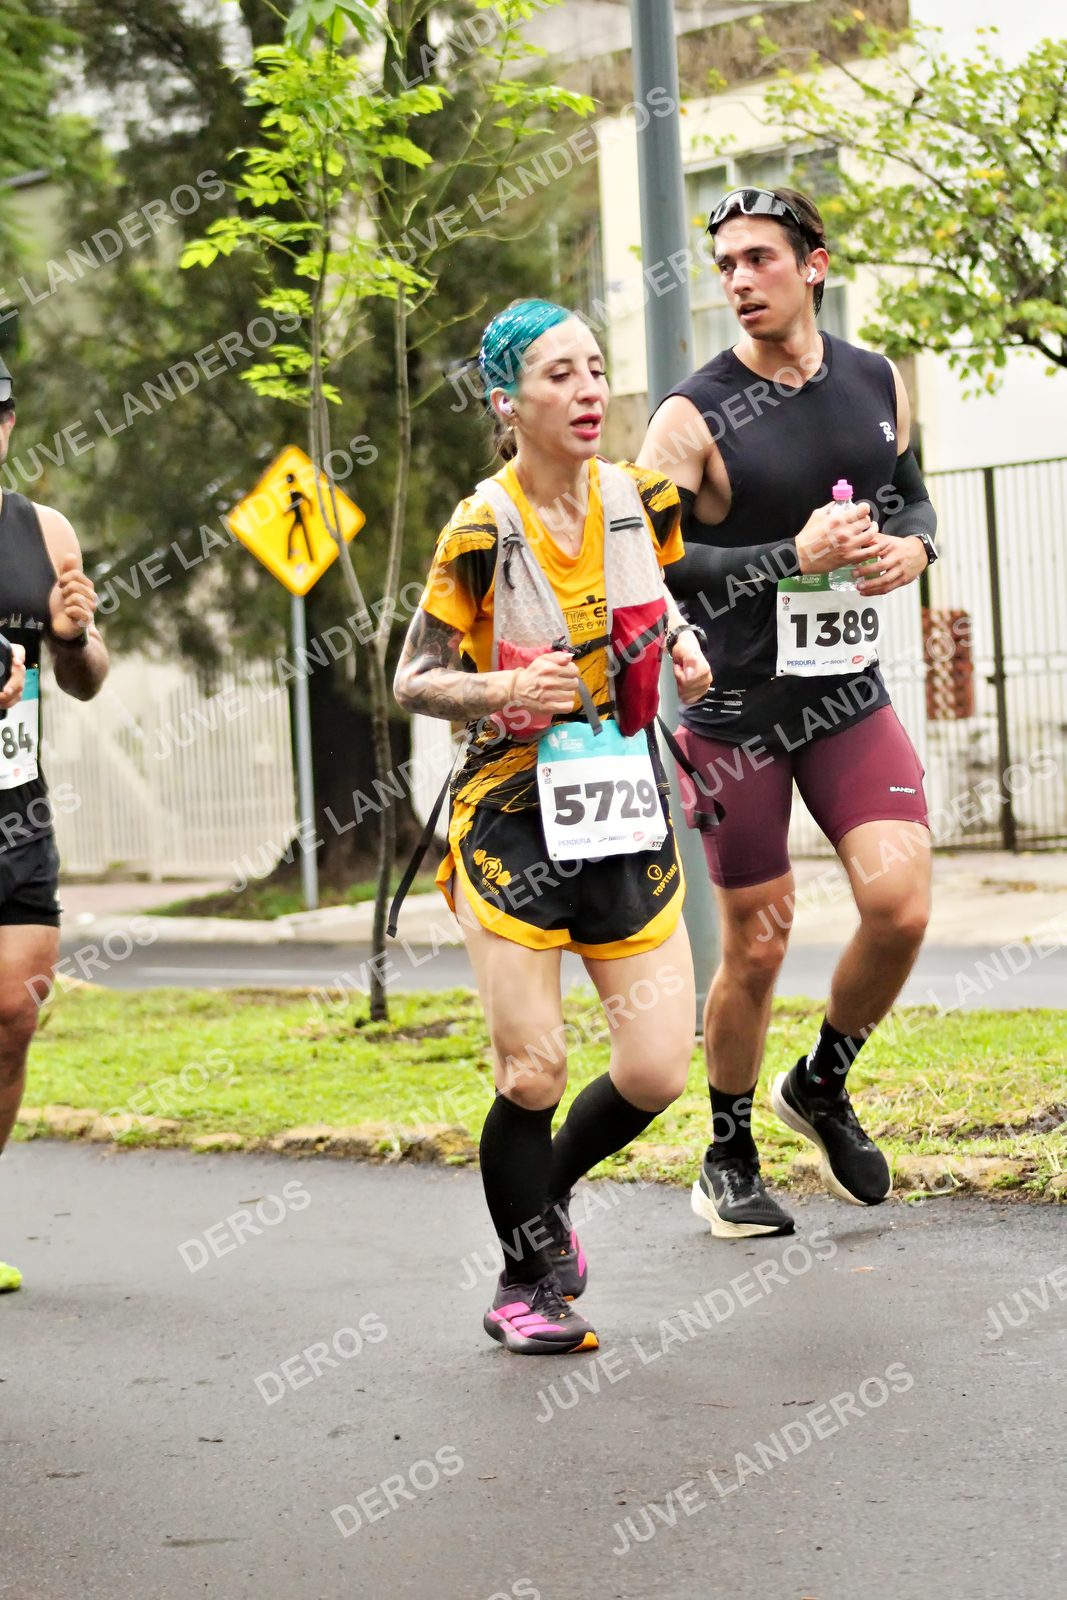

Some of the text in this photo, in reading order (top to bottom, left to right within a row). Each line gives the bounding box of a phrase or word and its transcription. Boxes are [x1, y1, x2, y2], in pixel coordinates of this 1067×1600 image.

[791, 608, 879, 648] 1389
[553, 779, 658, 826] 5729
[558, 836, 592, 847] PERDURA
[653, 863, 677, 896] TOPTIME
